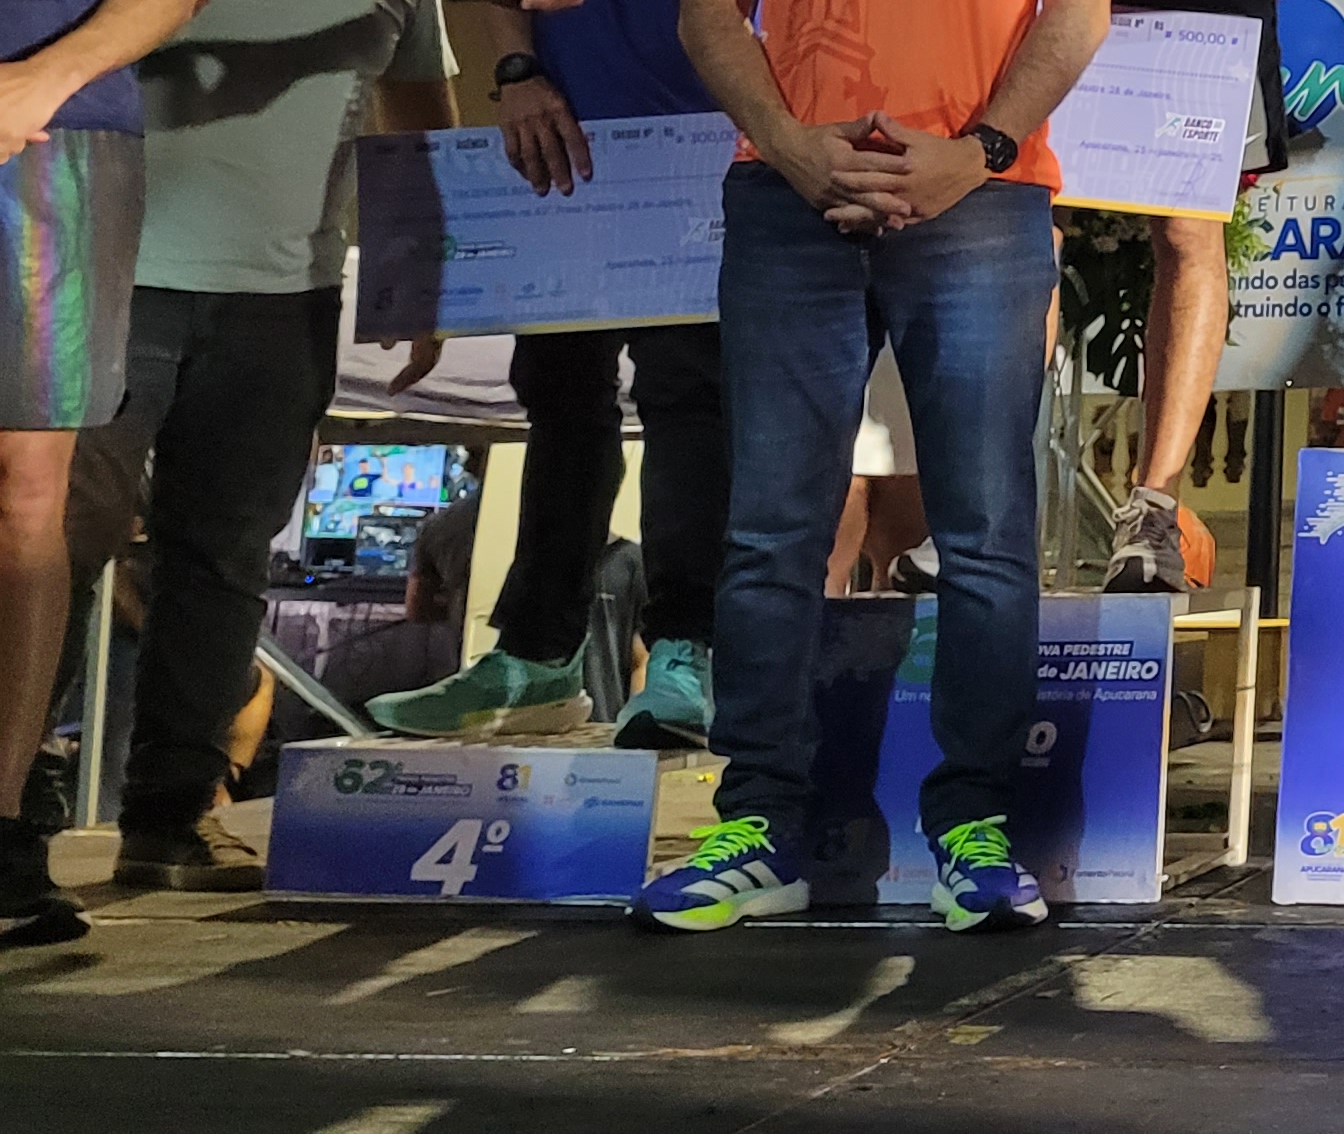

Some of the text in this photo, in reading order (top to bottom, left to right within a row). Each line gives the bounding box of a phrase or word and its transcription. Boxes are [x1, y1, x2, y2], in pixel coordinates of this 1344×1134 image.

[1178, 29, 1226, 46] 500,00
[1184, 117, 1213, 130] BANCO
[1182, 129, 1220, 143] ESPORTE
[1283, 268, 1320, 289] das
[1235, 296, 1313, 318] truindo
[1317, 301, 1331, 317] o
[1063, 643, 1131, 656] PEDESTRE
[1037, 661, 1159, 681] de JANEIRO
[895, 687, 1157, 703] Um Apucarana
[496, 763, 532, 792] 81
[410, 818, 511, 896] 4º
